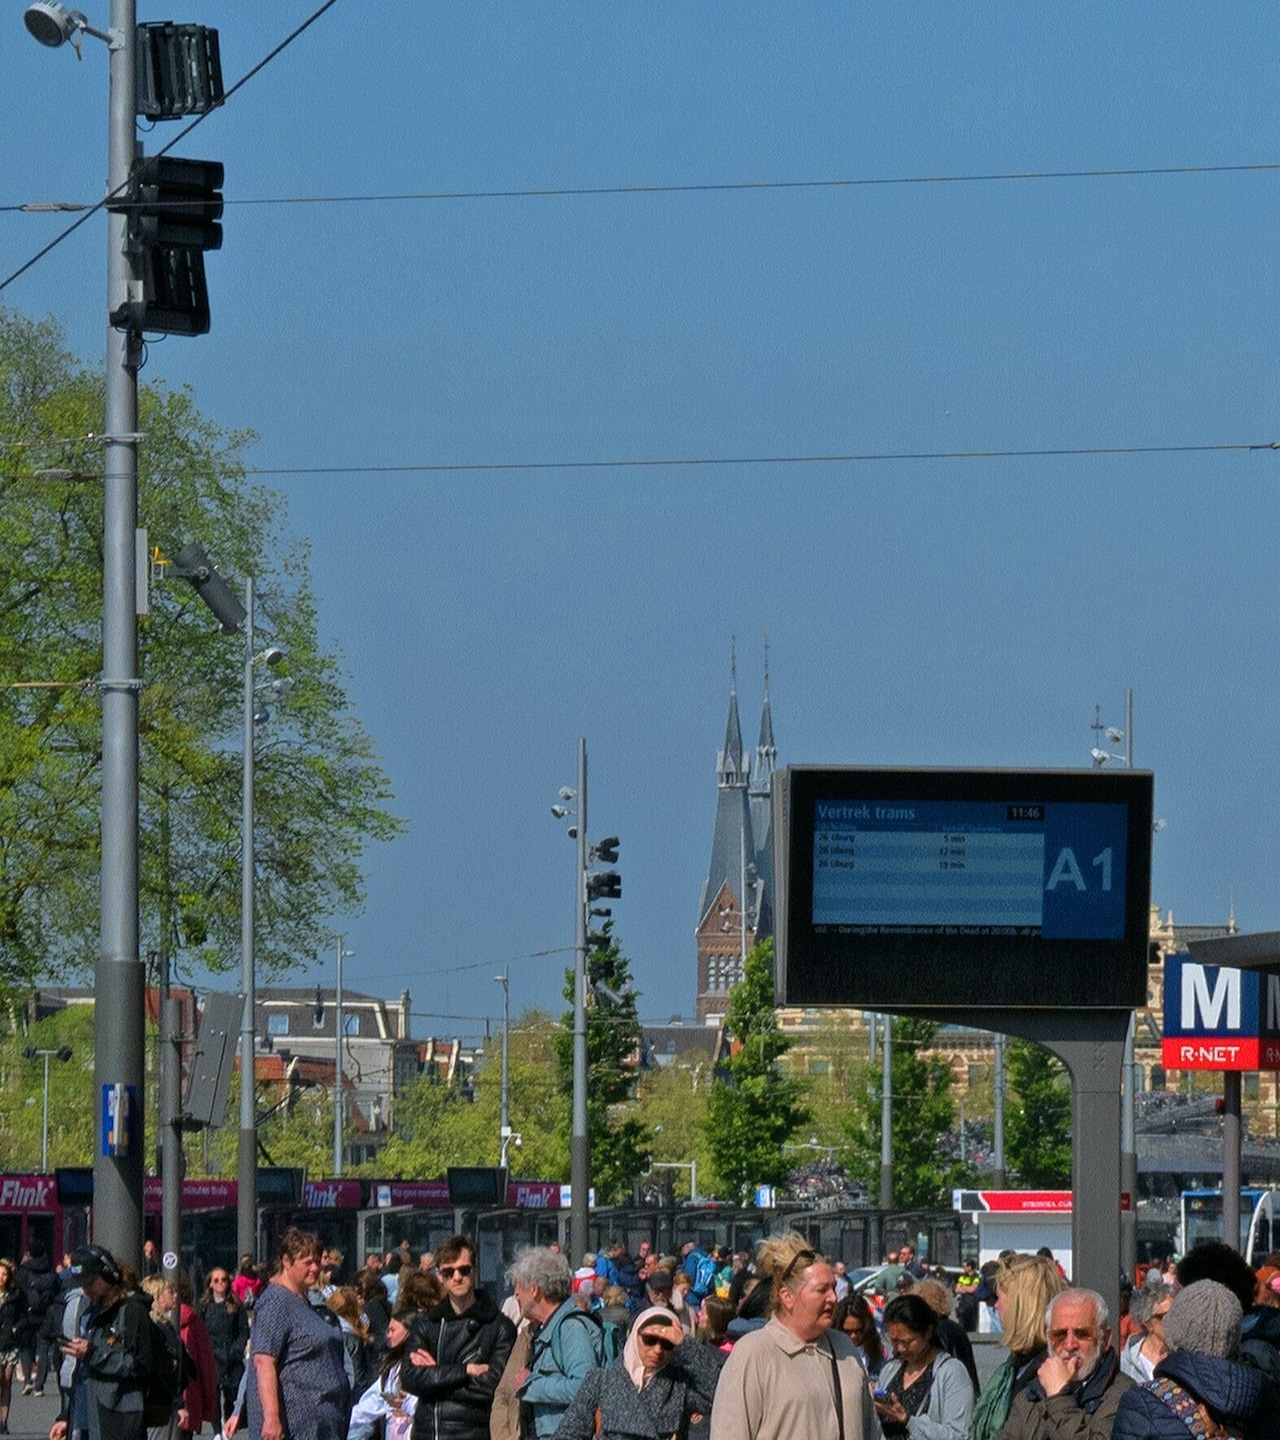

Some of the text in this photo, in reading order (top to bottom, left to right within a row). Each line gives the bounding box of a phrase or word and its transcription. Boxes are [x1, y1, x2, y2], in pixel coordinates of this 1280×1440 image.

[818, 805, 916, 820] Vertrek trams
[1011, 807, 1041, 819] 11:46
[1046, 847, 1112, 891] A1
[1181, 963, 1241, 1029] M
